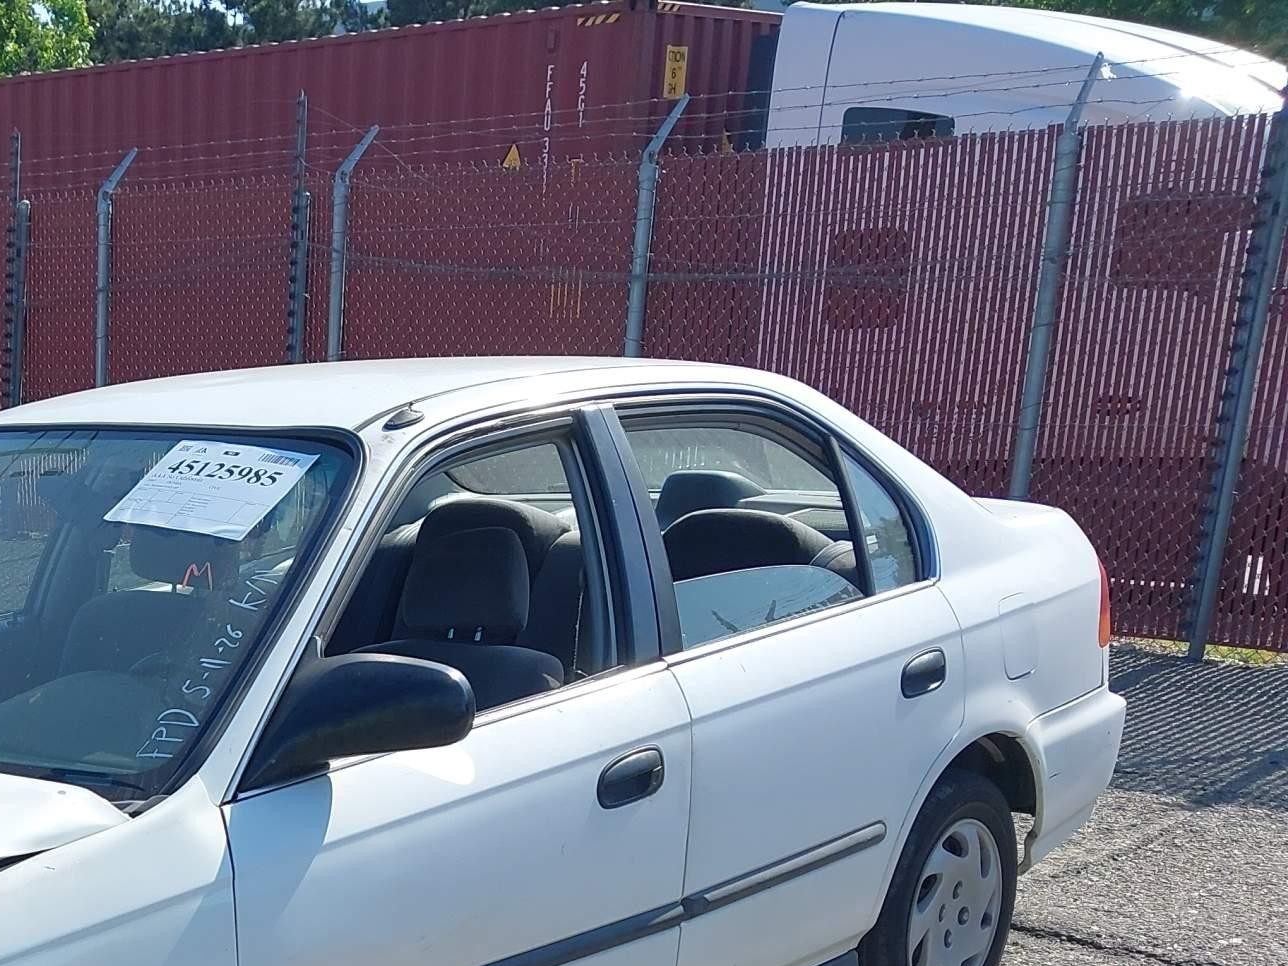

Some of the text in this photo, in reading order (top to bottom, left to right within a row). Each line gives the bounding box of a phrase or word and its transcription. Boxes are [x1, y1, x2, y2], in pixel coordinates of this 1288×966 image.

[543, 64, 555, 131] FFAU
[167, 458, 283, 487] 45125985
[182, 561, 213, 592] M
